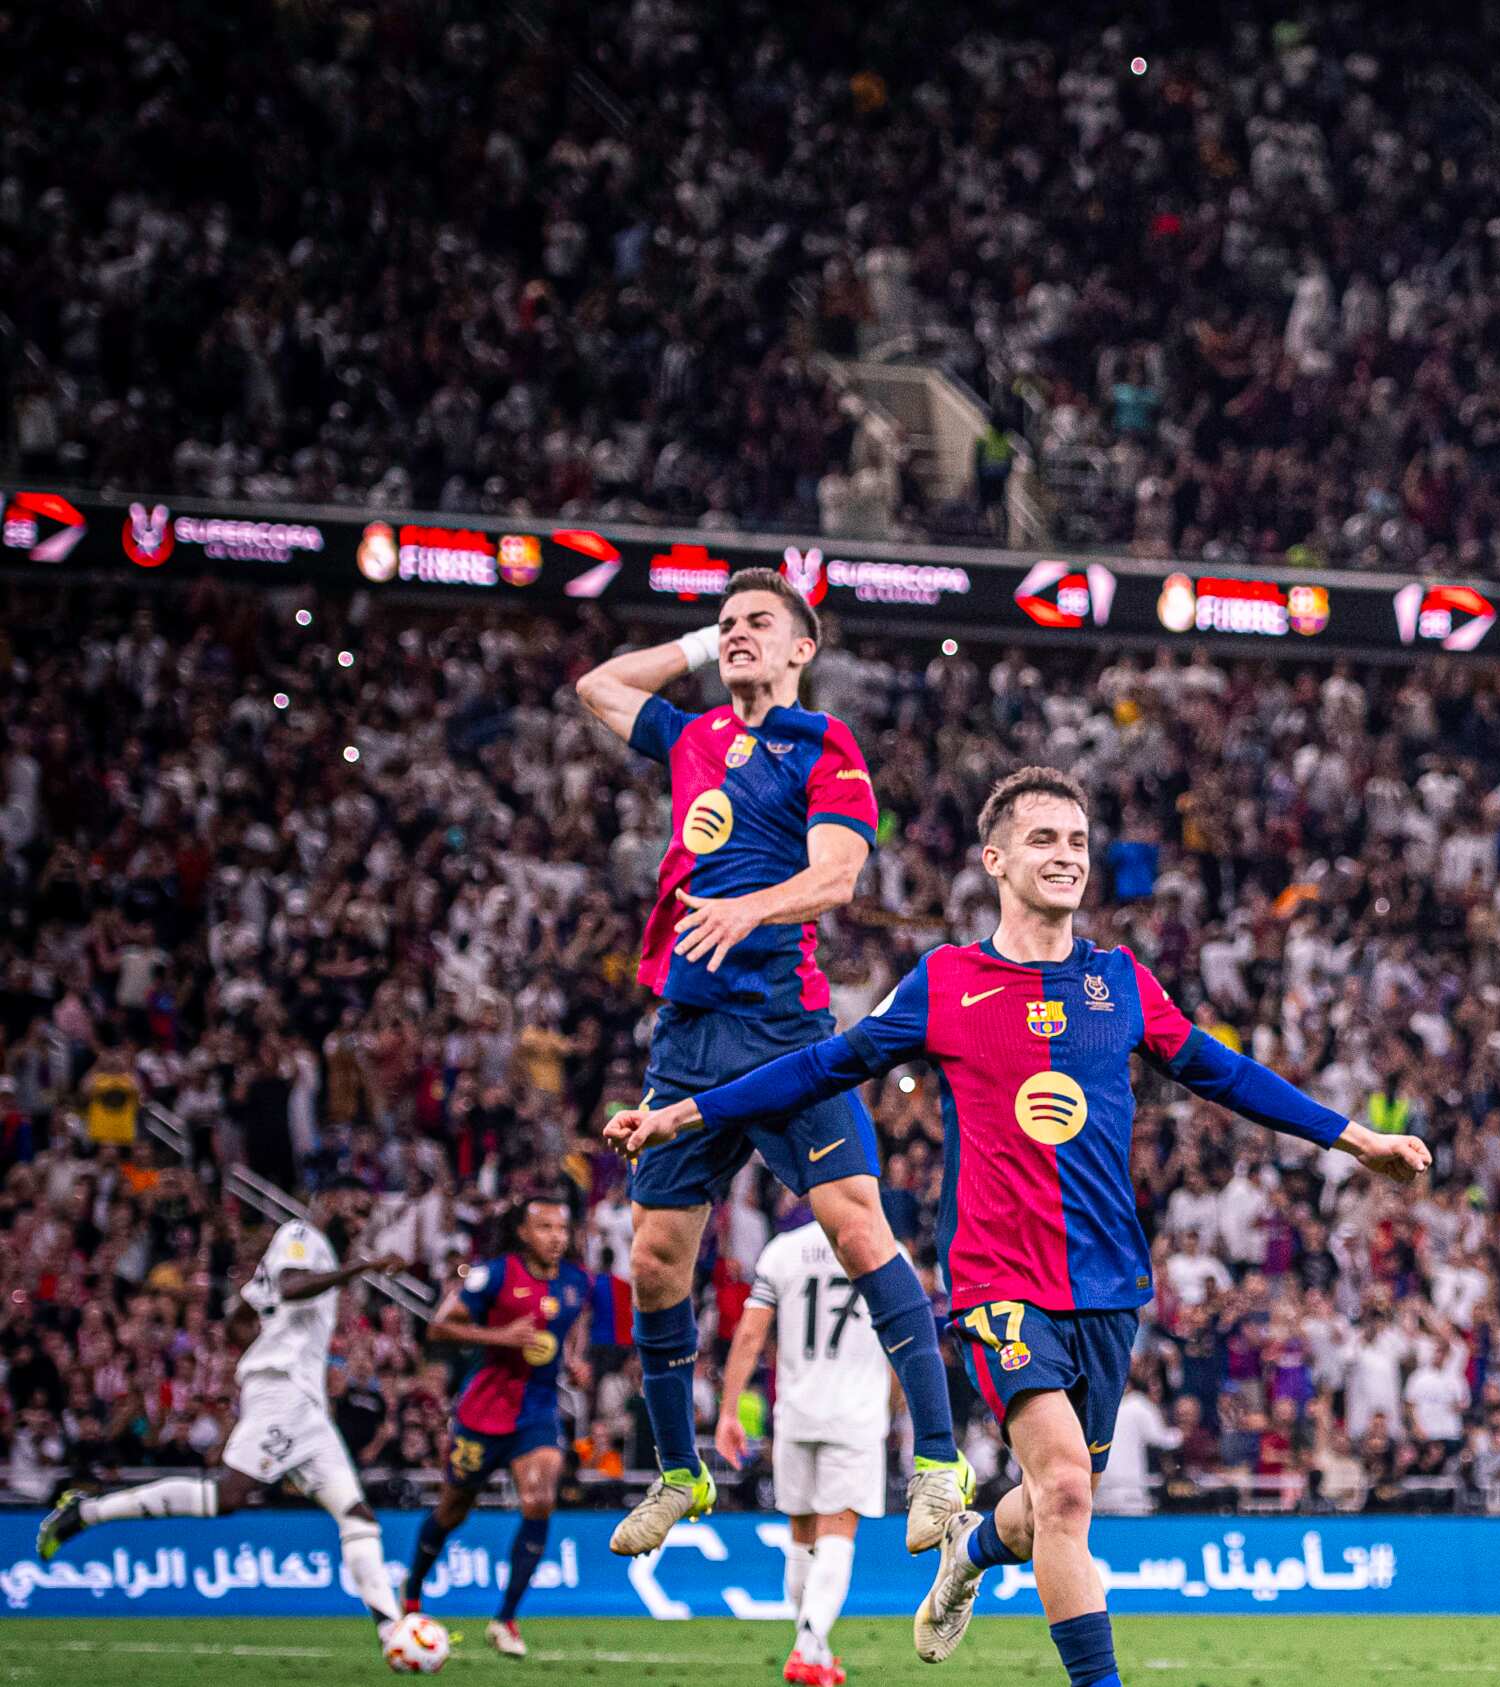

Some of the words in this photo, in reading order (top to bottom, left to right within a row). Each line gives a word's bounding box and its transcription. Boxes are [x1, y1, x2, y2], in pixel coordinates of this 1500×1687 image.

[803, 1274, 861, 1360] 17
[964, 1301, 1024, 1352] 17
[0, 1547, 187, 1609] الراجحي
